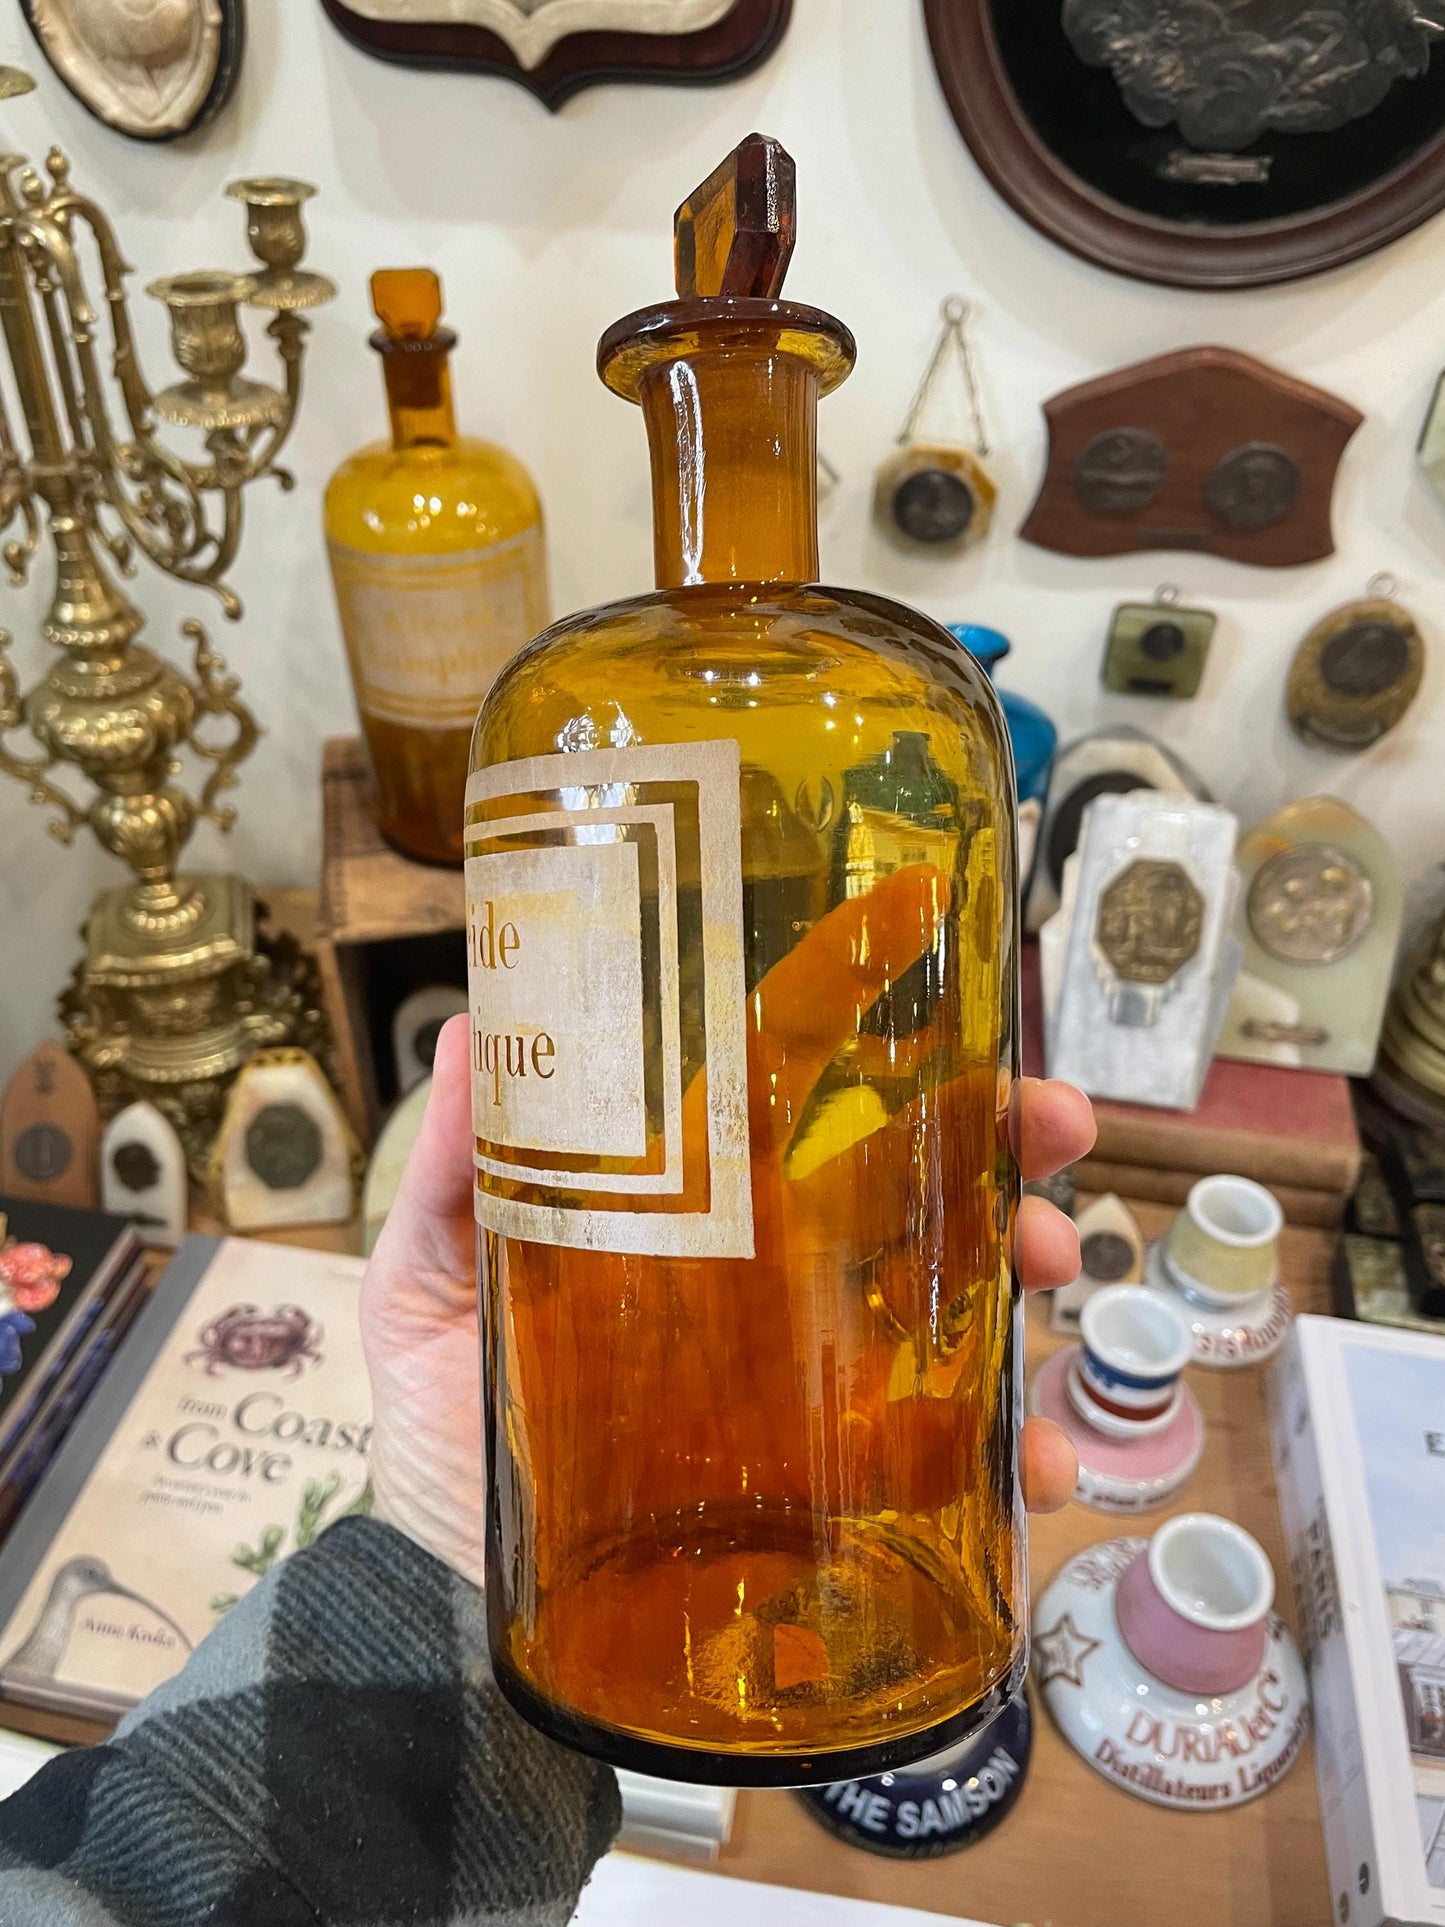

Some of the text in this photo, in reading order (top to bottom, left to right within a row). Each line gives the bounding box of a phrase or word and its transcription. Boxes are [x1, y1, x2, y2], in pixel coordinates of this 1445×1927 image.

[468, 901, 521, 970] ide
[167, 1422, 294, 1485] Cove
[824, 1746, 1021, 1839] THE SAMSON
